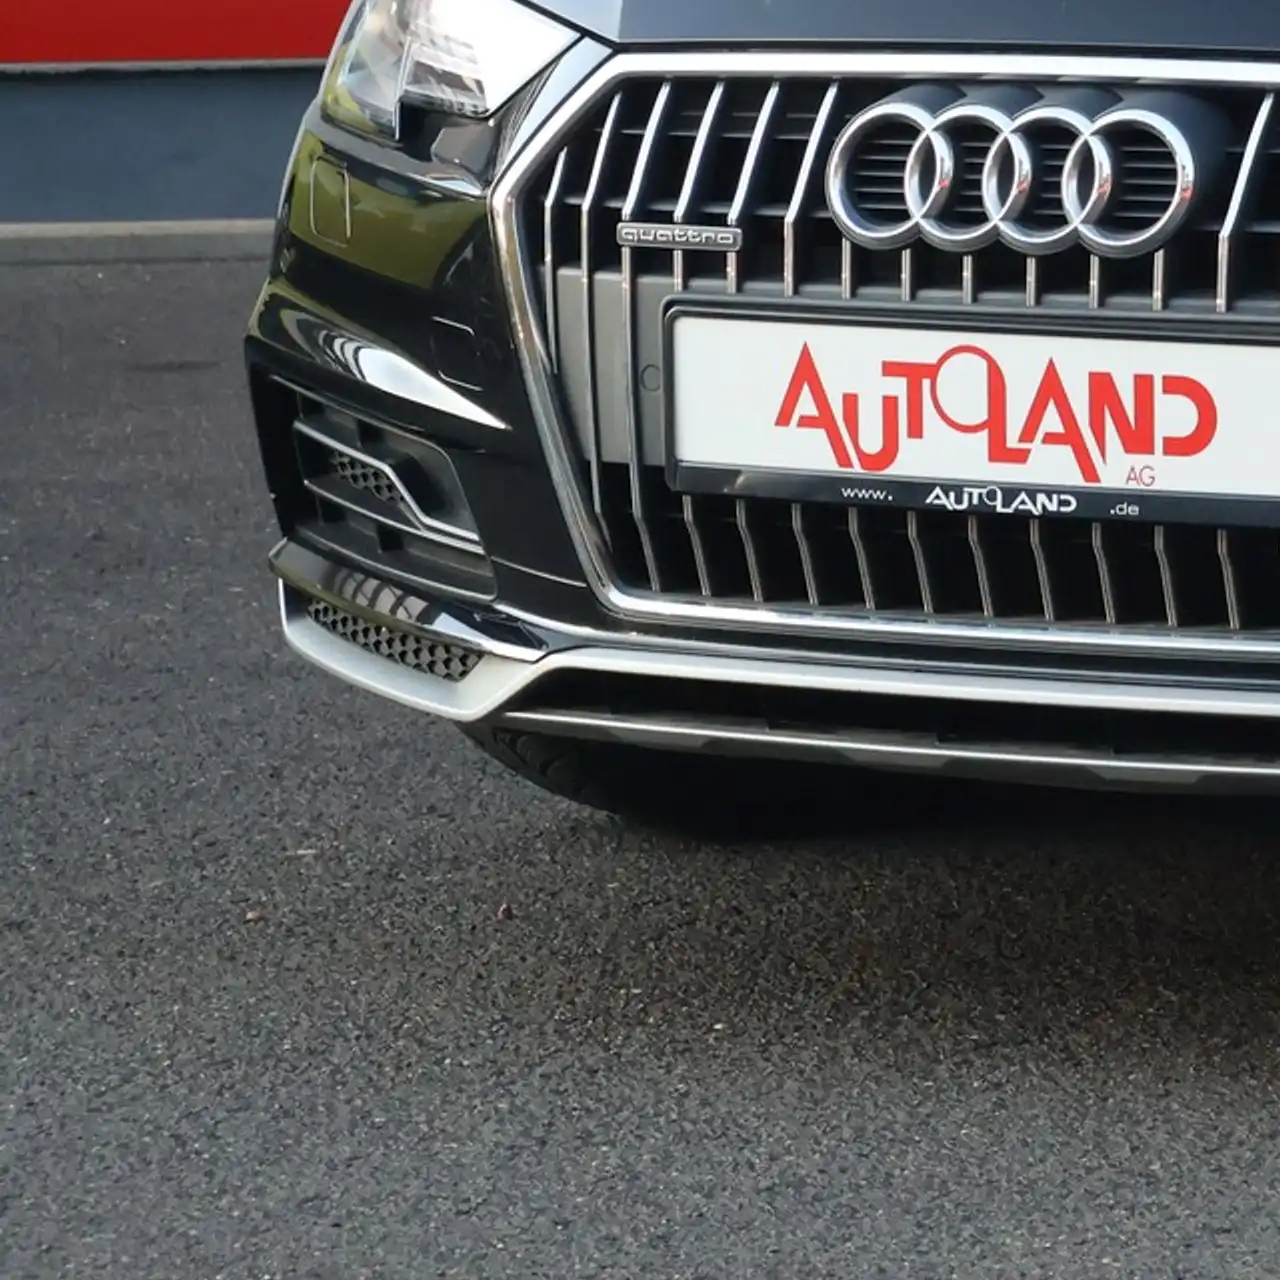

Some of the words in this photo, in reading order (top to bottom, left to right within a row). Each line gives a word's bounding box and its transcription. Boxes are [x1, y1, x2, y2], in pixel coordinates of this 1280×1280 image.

[620, 227, 734, 245] quattro
[774, 341, 1218, 484] AUTOLAND
[1125, 464, 1156, 488] AG
[841, 486, 893, 502] www.
[925, 485, 1077, 516] AUTOLAND
[1109, 501, 1140, 516] .de
